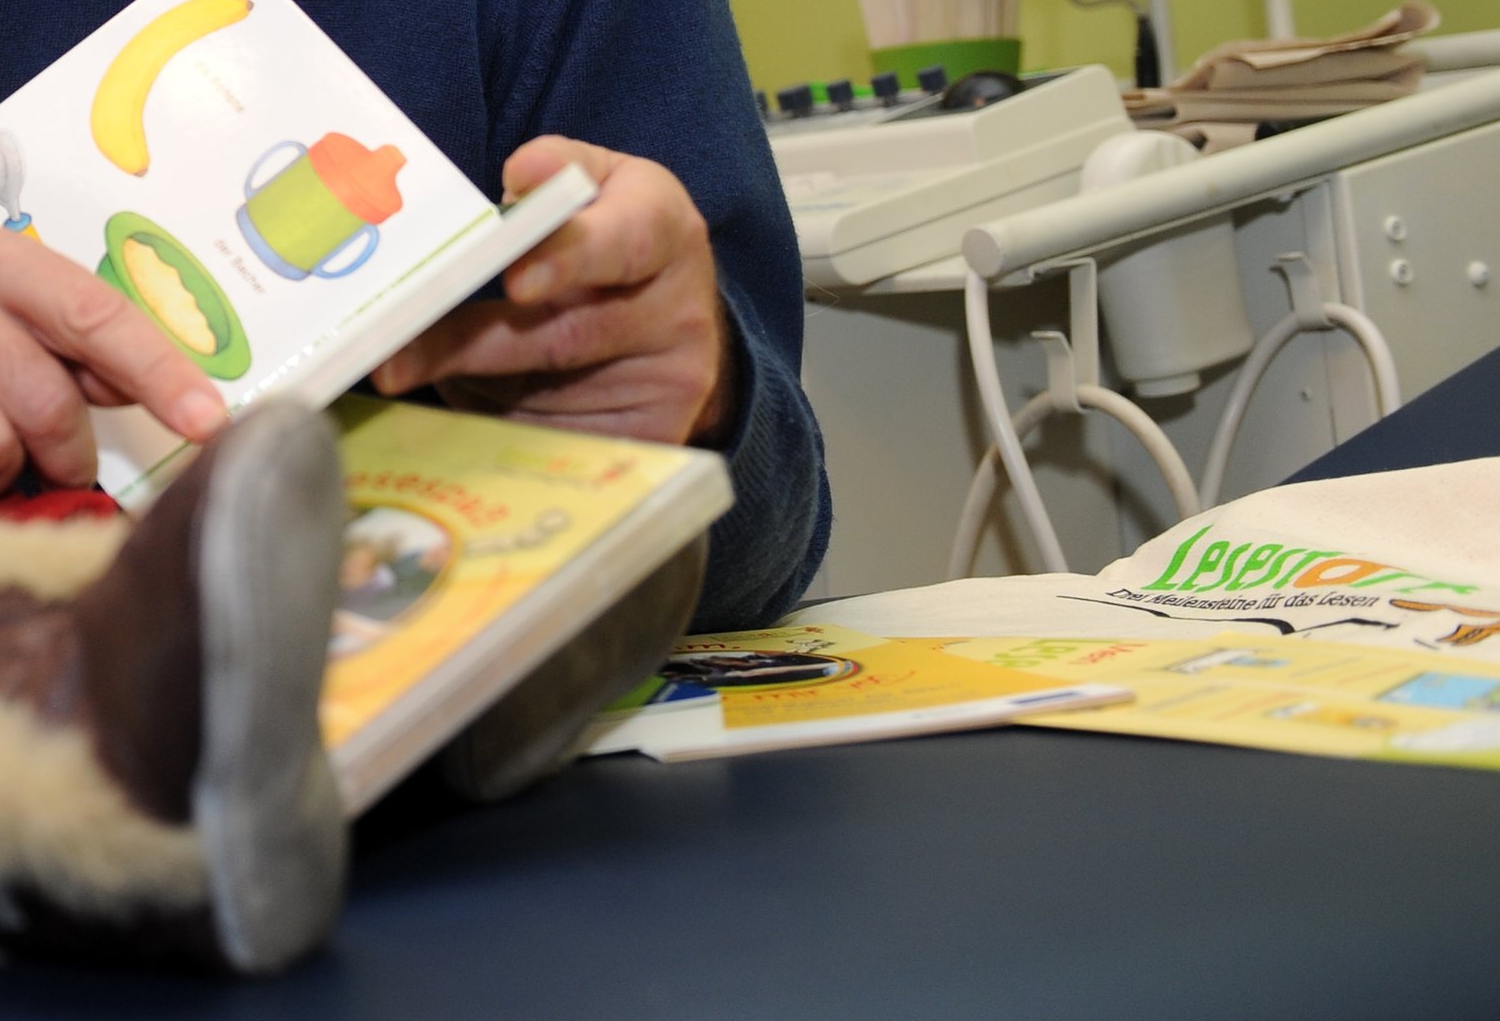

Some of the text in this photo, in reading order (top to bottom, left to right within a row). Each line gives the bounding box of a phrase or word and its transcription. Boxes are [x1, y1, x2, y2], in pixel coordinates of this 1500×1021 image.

[1105, 588, 1380, 611] Drei Meilensteine für das Lesen
